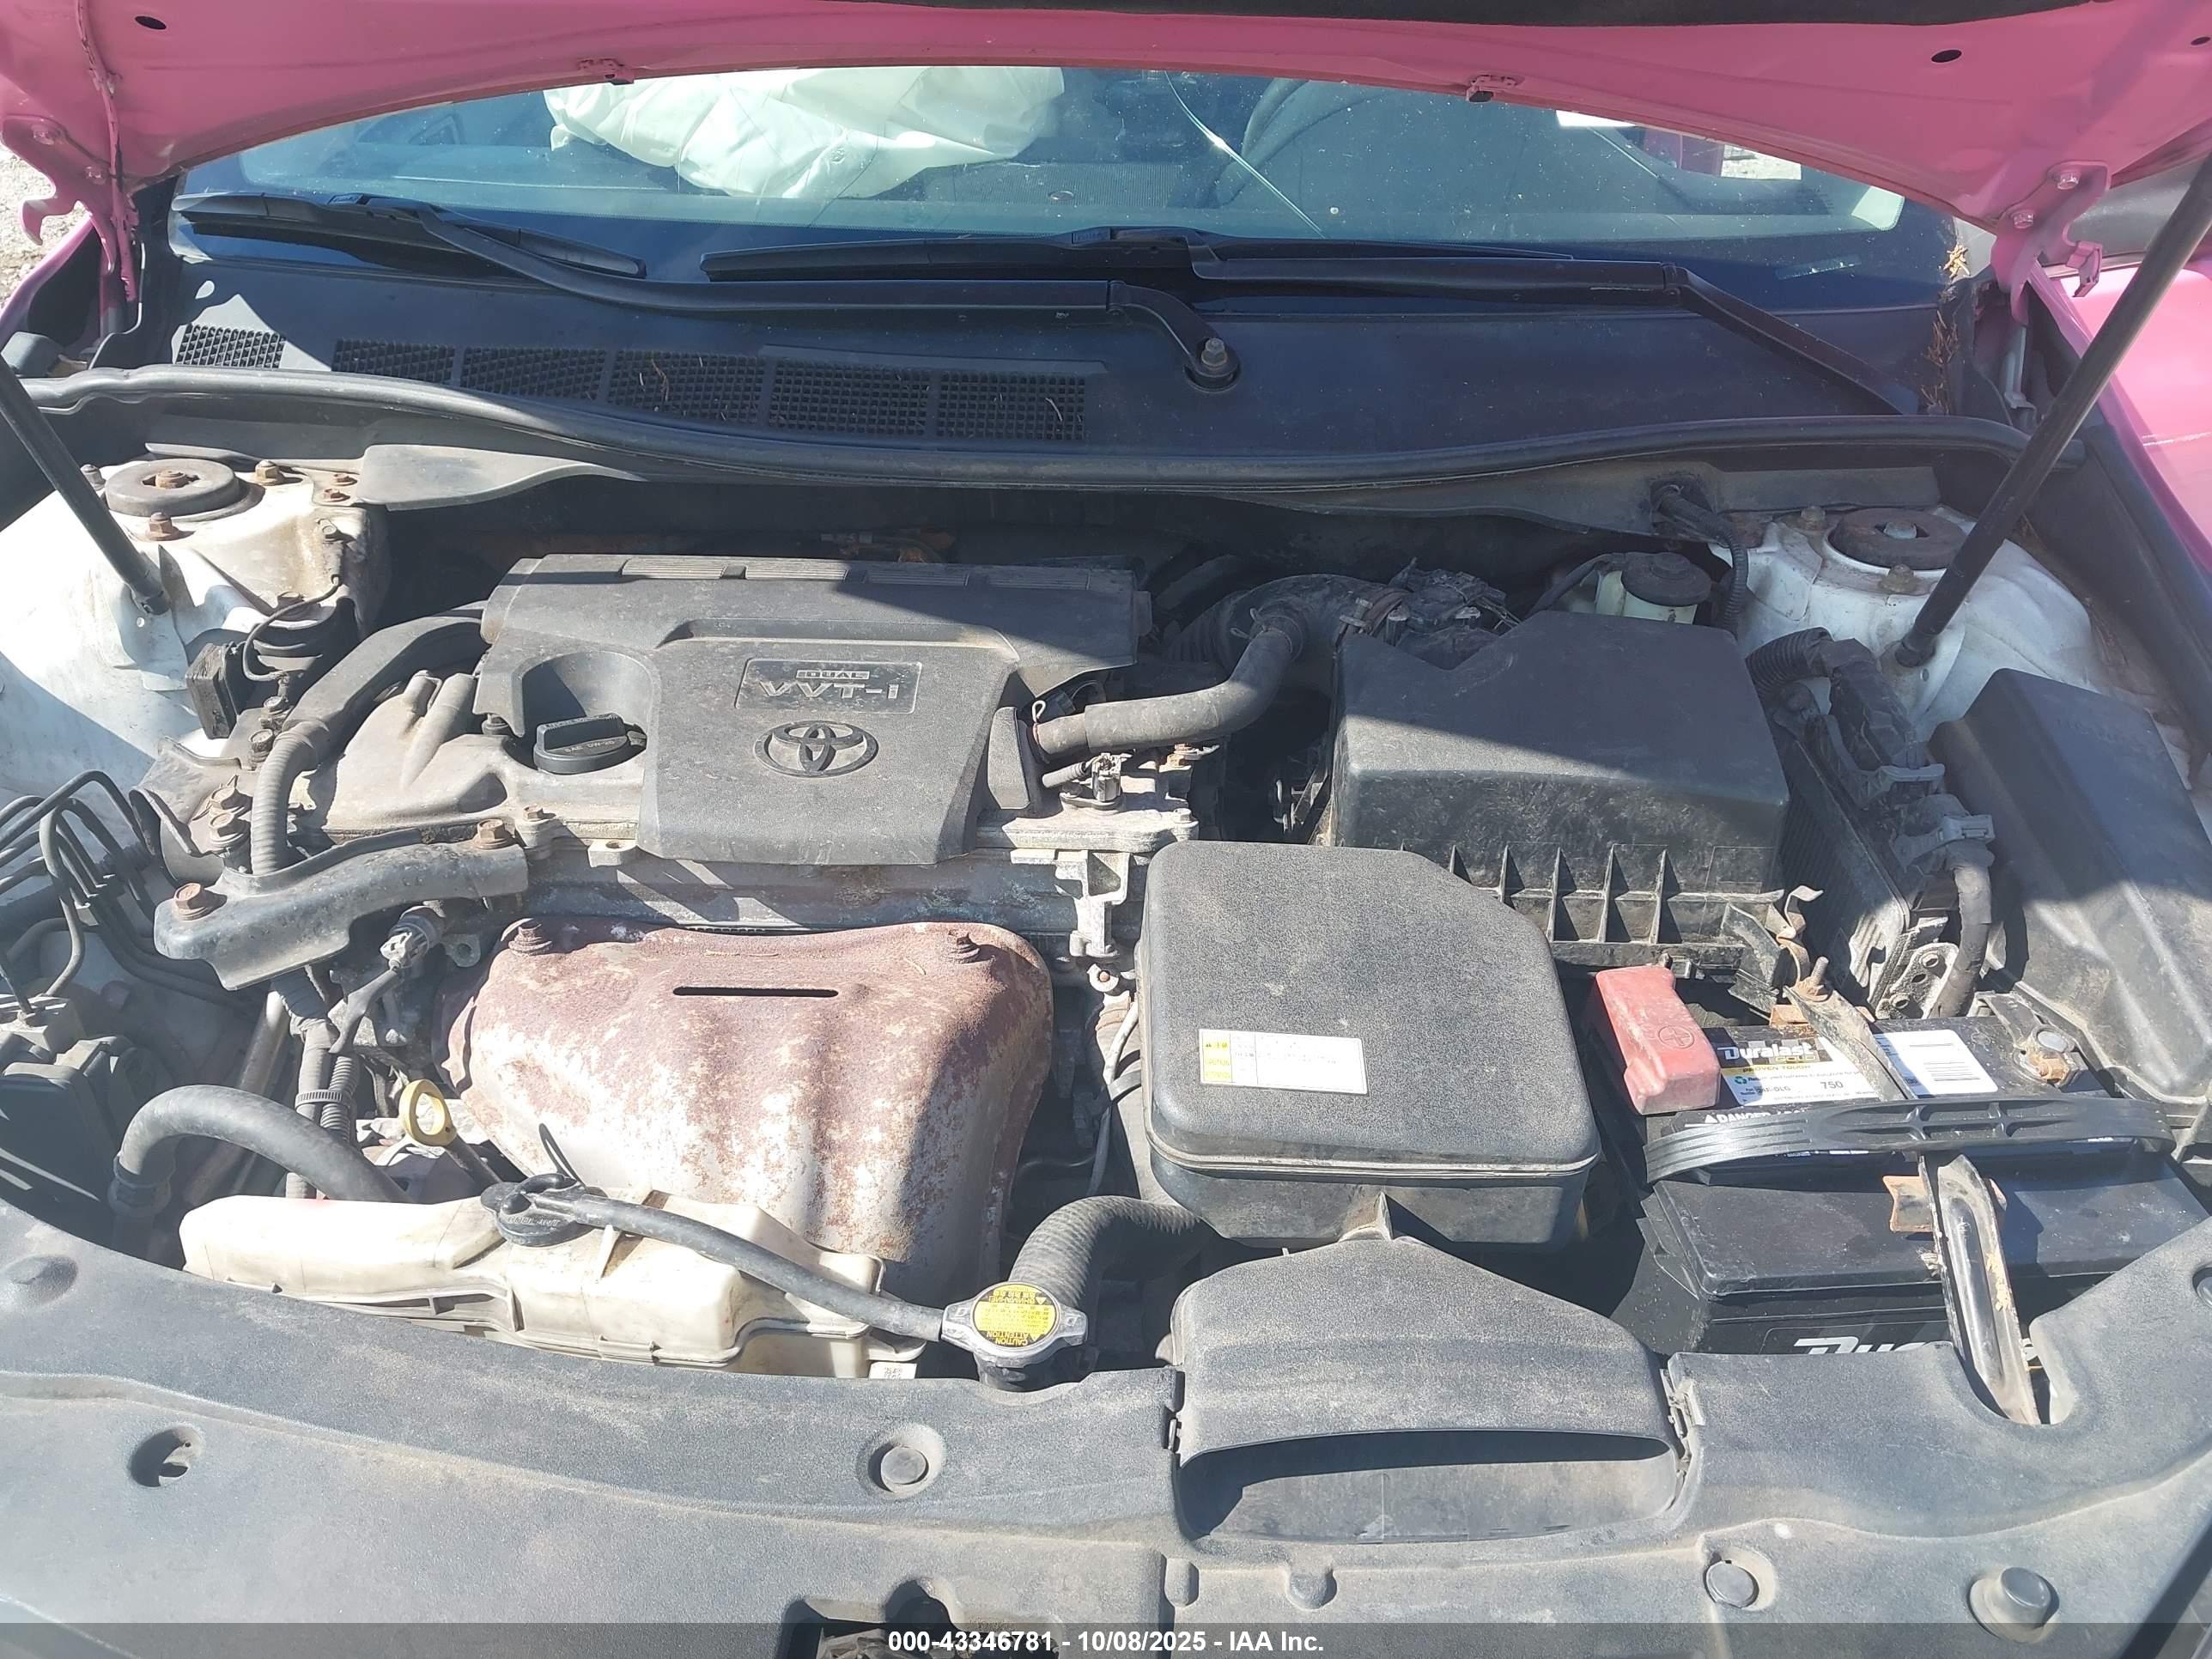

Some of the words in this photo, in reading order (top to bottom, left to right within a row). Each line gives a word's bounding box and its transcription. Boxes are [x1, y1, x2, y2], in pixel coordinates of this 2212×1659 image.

[800, 671, 867, 679] DUAL
[1717, 1042, 1815, 1060] Duralast
[1775, 1054, 1816, 1063] GOLD
[1820, 1080, 1844, 1090] 750
[995, 1337, 1029, 1346] CAUTION
